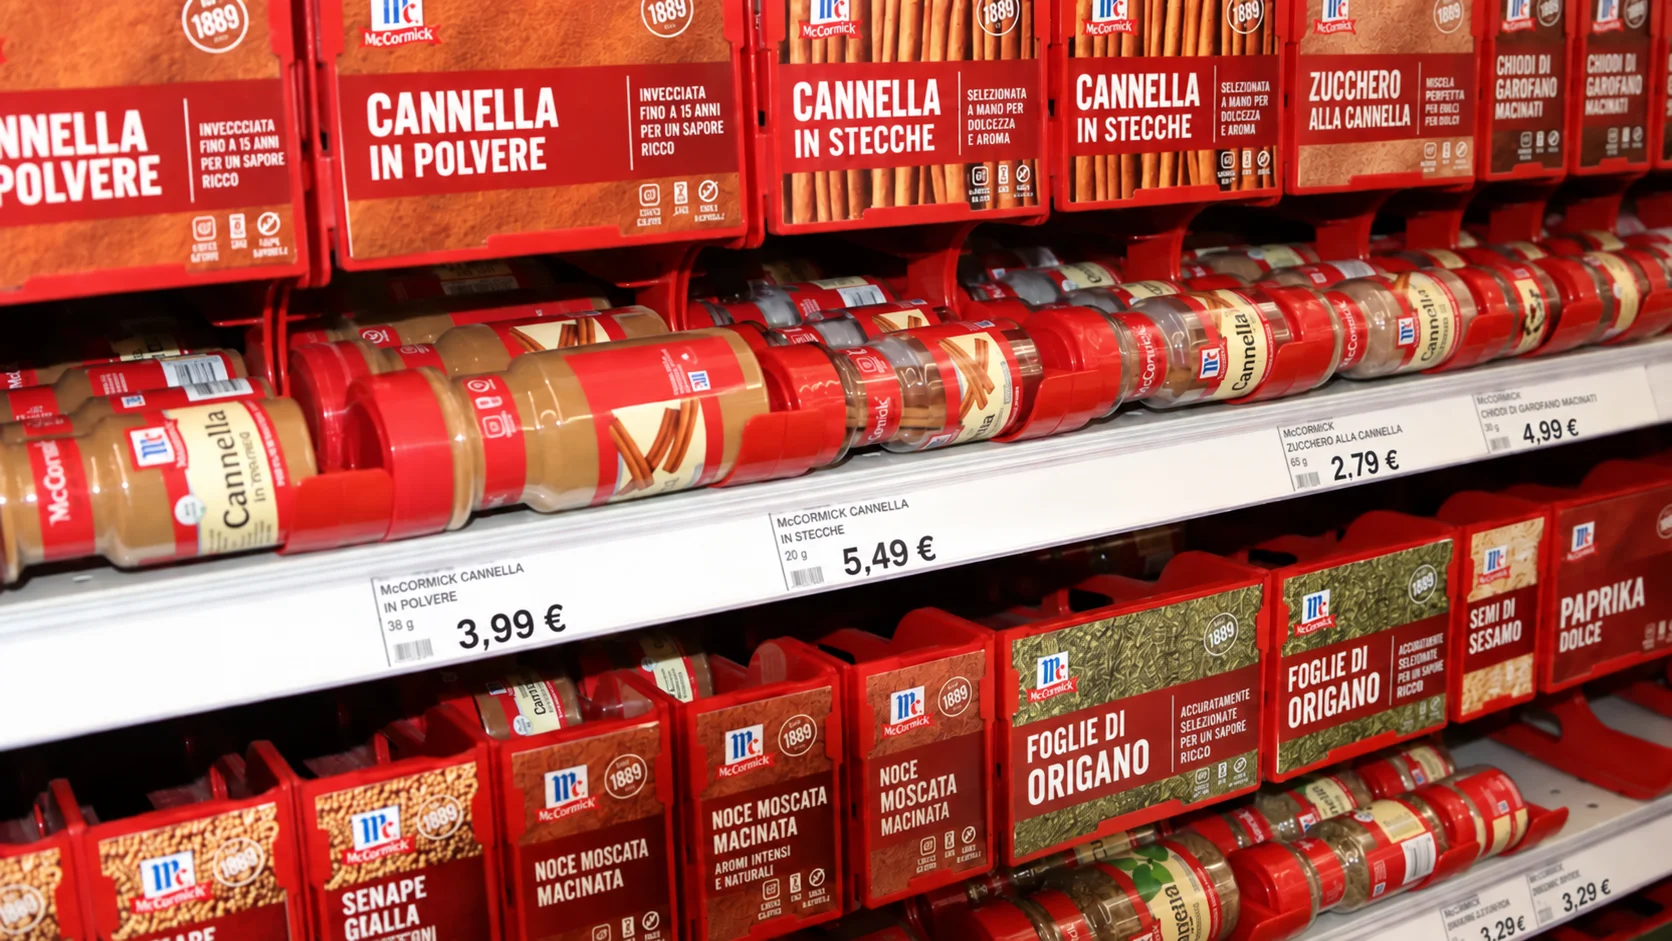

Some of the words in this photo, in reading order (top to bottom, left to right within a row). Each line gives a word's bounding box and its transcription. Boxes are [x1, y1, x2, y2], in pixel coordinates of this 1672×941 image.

[191, 4, 239, 39] 1889
[647, 0, 687, 26] 1889
[983, 1, 1014, 25] 1889
[1232, 1, 1260, 25] 1889
[365, 27, 433, 47] McCormick
[803, 22, 856, 37] McCormick
[1086, 20, 1132, 35] McCormick
[1496, 54, 1535, 75] CHIODI
[1538, 54, 1551, 74] DI
[1586, 53, 1623, 74] CHIODI
[1625, 53, 1637, 72] DI
[639, 85, 706, 102] INVECCIATA
[967, 87, 1027, 102] SELEZIONATA
[1076, 72, 1200, 111] CANNELLA
[1221, 81, 1270, 93] SELEZIONATA
[1309, 69, 1401, 102] ZUCCHERO
[1495, 77, 1557, 99] GAROFANO
[1586, 75, 1642, 97] GAROFANO
[366, 86, 559, 139] CANNELLA
[640, 104, 665, 121] FINO
[669, 104, 678, 119] A
[681, 103, 692, 118] 15
[694, 102, 721, 117] ANNI
[793, 78, 941, 122] CANNELLA
[967, 104, 974, 116] A
[976, 103, 1004, 115] MANO
[1006, 101, 1024, 114] PER
[1221, 97, 1227, 108] A
[1228, 95, 1252, 107] MANO
[1253, 94, 1269, 107] PER
[1495, 101, 1543, 120] MACINATI
[967, 118, 1015, 131] DOLCEZZA
[1077, 117, 1098, 143] IN
[1104, 113, 1192, 143] STECCHE
[1221, 109, 1261, 121] DOLCEZZA
[1309, 106, 1341, 130] ALLA
[1345, 103, 1411, 129] CANNELLA
[640, 123, 661, 139] PER
[664, 122, 680, 137] UN
[682, 120, 724, 136] SAPORE
[794, 128, 820, 158] IN
[829, 123, 935, 156] STECCHE
[968, 134, 973, 146] E
[976, 132, 1010, 145] AROMA
[1221, 125, 1226, 136] E
[1228, 123, 1256, 135] AROMA
[200, 138, 226, 153] FINO
[229, 138, 237, 151] A
[239, 137, 251, 151] 15
[254, 135, 279, 150] ANNI
[641, 141, 675, 157] RICCO
[201, 156, 222, 171] PER
[225, 155, 241, 169] UN
[243, 152, 286, 168] SAPORE
[370, 143, 404, 181] IN
[414, 136, 547, 179] POLVERE
[202, 172, 239, 189] RICCO
[1232, 313, 1255, 392] Cannella
[1508, 405, 1517, 415] DI
[1283, 422, 1335, 438] McCORMICK
[1286, 436, 1334, 453] ZUCCHERO
[1335, 432, 1357, 445] ALLA
[1358, 424, 1403, 440] CANNELLA
[1523, 419, 1562, 445] 4,99
[1567, 418, 1579, 437] €
[204, 409, 250, 529] Cannella
[1290, 457, 1301, 467] 65
[1302, 458, 1308, 467] g
[1331, 450, 1379, 481] 2,79
[1385, 449, 1399, 470] €
[777, 508, 848, 528] McCORMICK
[849, 499, 909, 516] CANNELLA
[780, 533, 793, 544] IN
[795, 524, 845, 542] STECCHE
[785, 550, 798, 561] 20
[801, 550, 808, 561] g
[842, 538, 909, 576] 5,49
[916, 535, 937, 561] €
[380, 572, 458, 596] McCORMICK
[460, 563, 525, 582] CANNELLA
[384, 602, 398, 614] IN
[400, 590, 458, 611] POLVERE
[1470, 602, 1500, 629] SEMI
[1503, 597, 1516, 619] DI
[1560, 576, 1645, 629] PAPRIKA
[387, 620, 403, 632] 38
[406, 619, 415, 631] g
[456, 609, 535, 652] 3,99
[544, 604, 566, 633] €
[1208, 621, 1235, 649] 1889
[1469, 619, 1522, 655] SESAMO
[1559, 621, 1603, 653] DOLCE
[1288, 651, 1347, 693] FOGLIE
[1351, 645, 1368, 674] DI
[942, 684, 968, 710] 1889
[1029, 681, 1074, 701] McCormick
[1180, 688, 1250, 719] ACCURATAMENTE
[1287, 671, 1380, 729] ORIGANO
[884, 716, 929, 737] McCormick
[1180, 707, 1238, 734] SELEZIONATE
[1180, 734, 1198, 748] PER
[1200, 730, 1213, 744] UN
[1215, 719, 1247, 741] SAPORE
[783, 723, 812, 749] 1889
[1027, 717, 1098, 764] FOGLIE
[1105, 709, 1125, 741] DI
[718, 754, 770, 778] McCormick
[1180, 745, 1211, 765] RICCO
[609, 763, 642, 791] 1889
[880, 759, 918, 787] NOCE
[1028, 738, 1149, 806] ORIGANO
[880, 773, 958, 814] MOSCATA
[424, 804, 458, 832] 1889
[539, 798, 597, 822] McCormick
[712, 803, 753, 830] NOCE
[757, 785, 828, 819] MOSCATA
[881, 801, 950, 836] MACINATA
[713, 816, 798, 855] MACINATA
[220, 847, 257, 878] 1889
[346, 839, 410, 863] McCormick
[534, 854, 577, 882] NOCE
[581, 838, 649, 870] MOSCATA
[715, 856, 748, 876] AROMI
[751, 845, 791, 864] INTENSI
[537, 868, 624, 908] MACINATA
[715, 878, 722, 891] E
[724, 864, 774, 889] NATURALI
[135, 885, 207, 912] McCormick
[342, 875, 427, 916] SENAPE
[1562, 881, 1597, 913] 3,29
[1601, 879, 1611, 895] €
[344, 903, 420, 941] GIALLA
[1517, 915, 1526, 931] €
